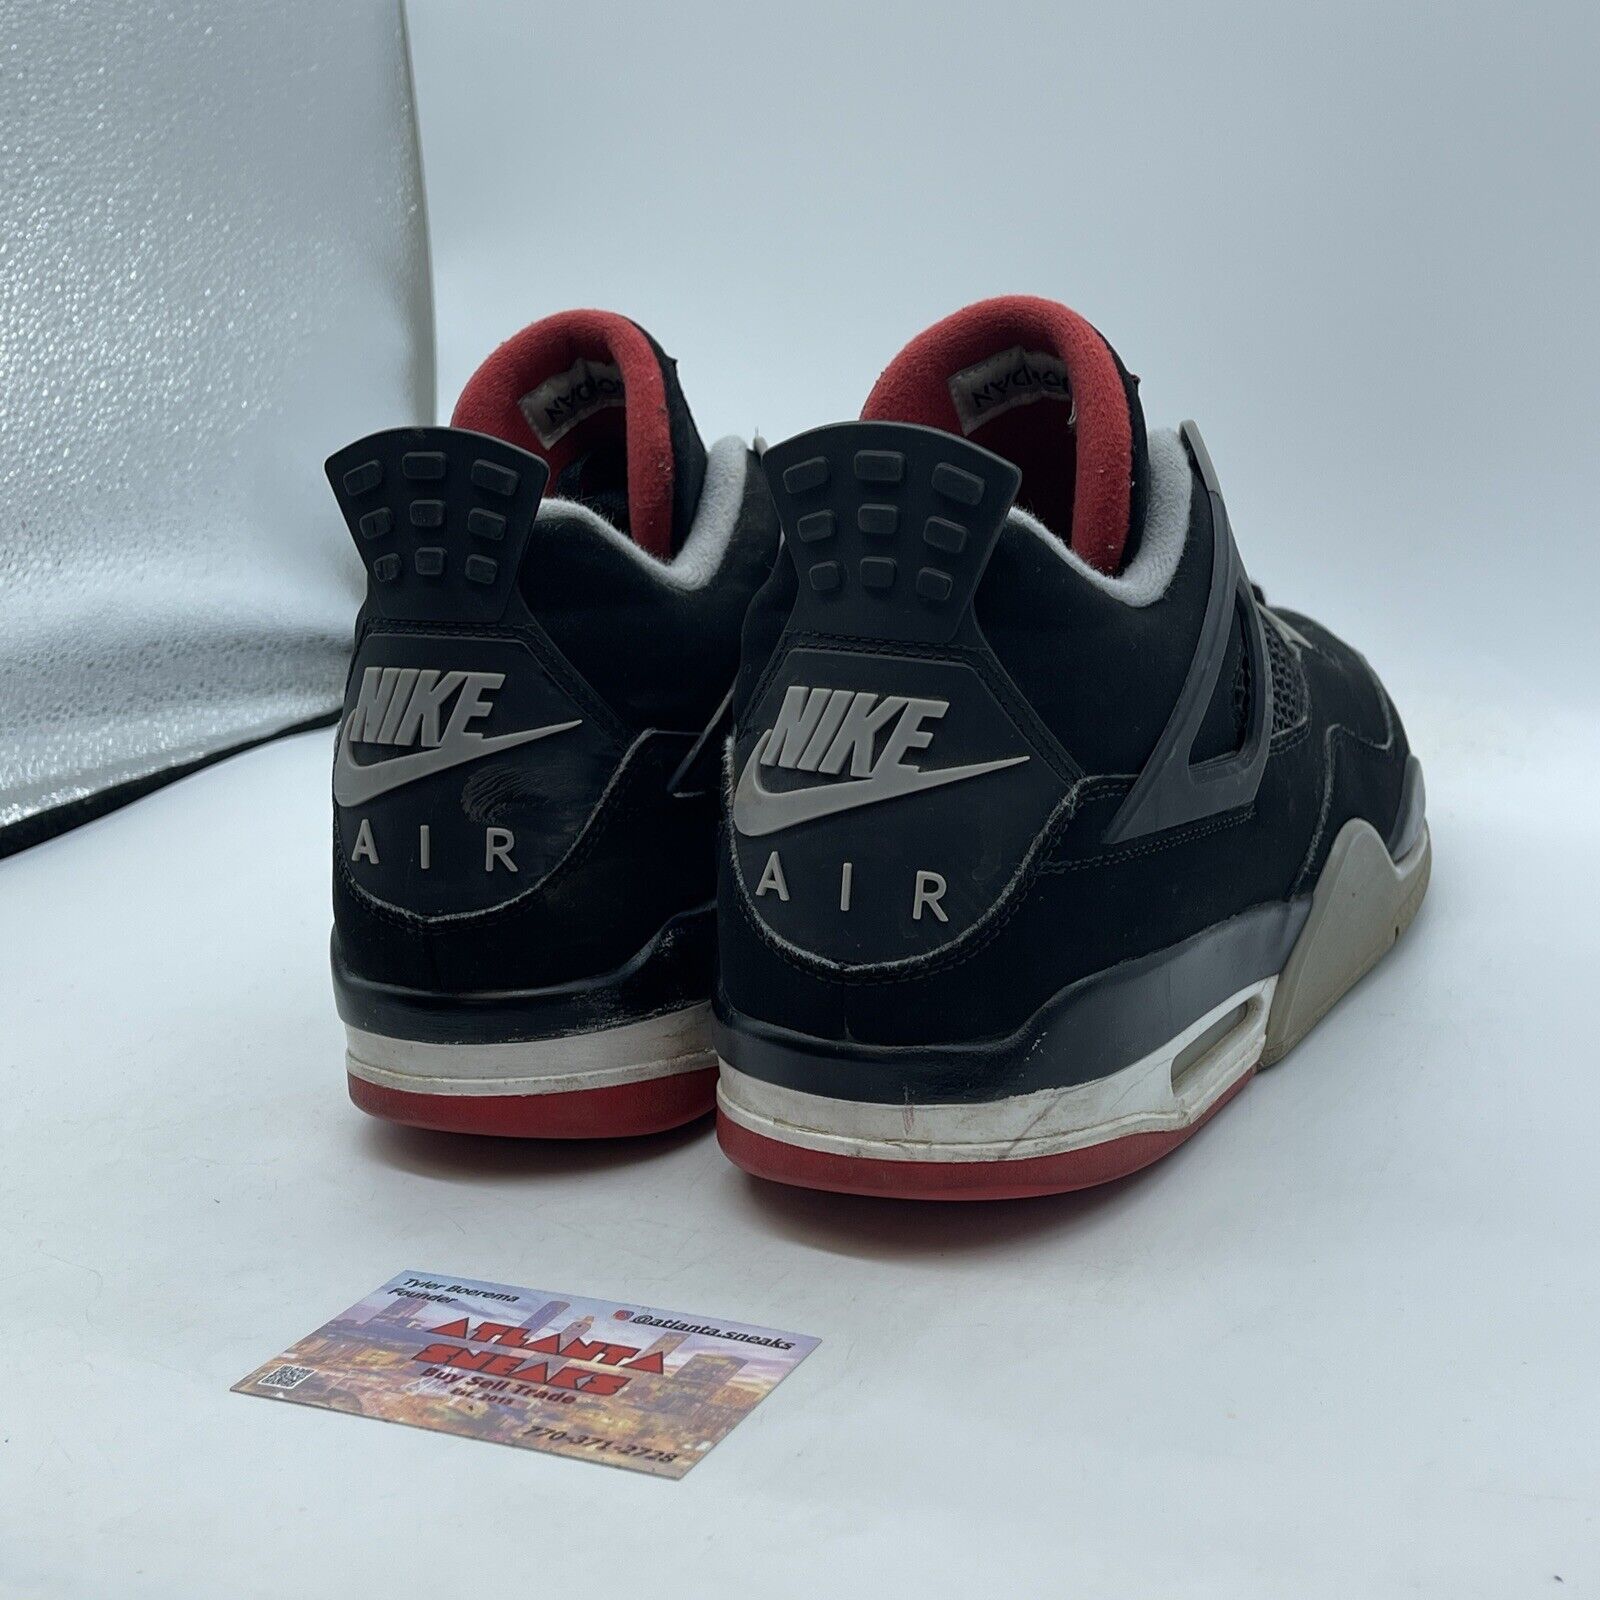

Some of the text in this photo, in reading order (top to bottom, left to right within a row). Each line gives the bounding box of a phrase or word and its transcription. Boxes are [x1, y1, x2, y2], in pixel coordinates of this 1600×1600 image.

[544, 375, 625, 426] ORDAN
[349, 666, 506, 748] NIKE
[760, 685, 950, 779] NIKE
[351, 818, 518, 872] AIR
[755, 850, 949, 922] AIR
[387, 1287, 458, 1304] Founder
[403, 1278, 520, 1303] Tyler Boerema
[425, 1317, 664, 1375] ATLANTA
[630, 1314, 796, 1350] @atlanta.sneaks
[411, 1343, 632, 1396] SNEAKS
[420, 1367, 577, 1404] Buy Sell Trade
[523, 1425, 679, 1463] 770-371-2728
